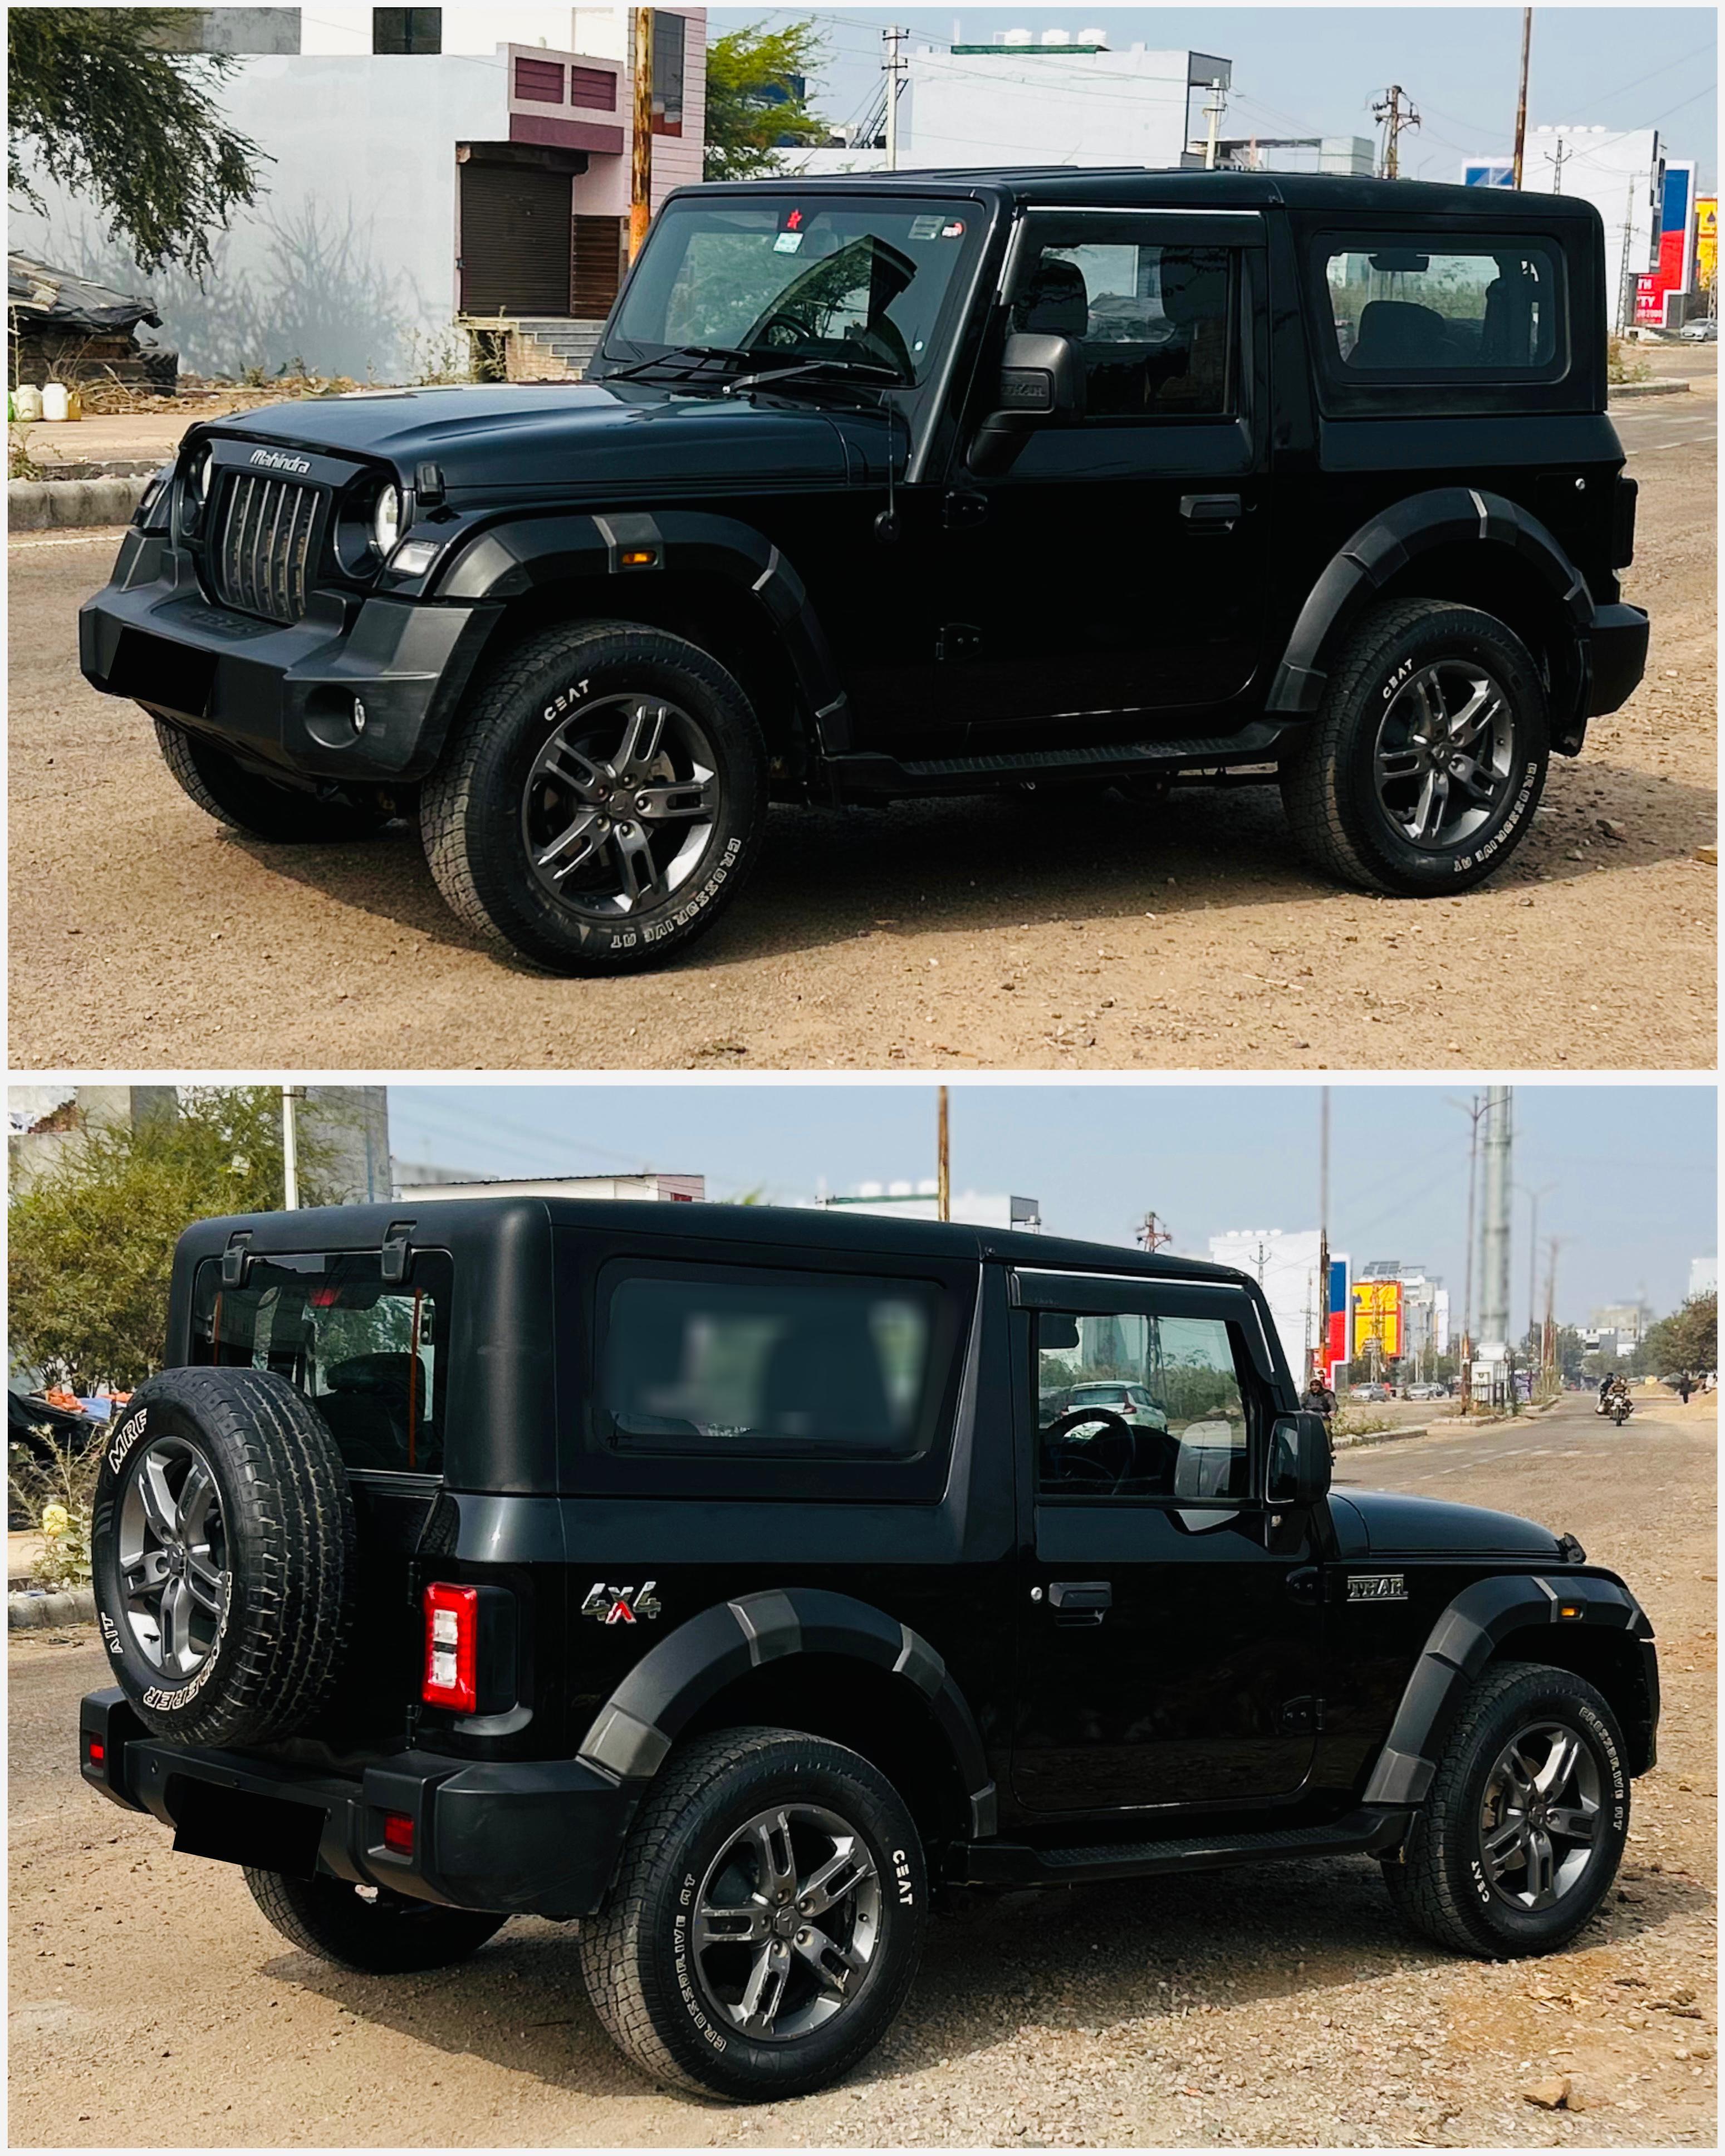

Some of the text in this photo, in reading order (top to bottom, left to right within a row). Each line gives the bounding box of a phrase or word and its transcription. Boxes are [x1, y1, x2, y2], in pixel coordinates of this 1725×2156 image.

[249, 449, 311, 473] Mahindra
[544, 679, 589, 721] CEAT
[1383, 658, 1412, 699] CEAT
[611, 837, 742, 949] CROSSDRIVE AT
[108, 1408, 148, 1474] MRF
[1347, 1576, 1408, 1599] THAR
[893, 1850, 913, 1905] CEAT
[1471, 1860, 1490, 1903] CEAT
[674, 1914, 727, 2052] CROSSDRIVE
